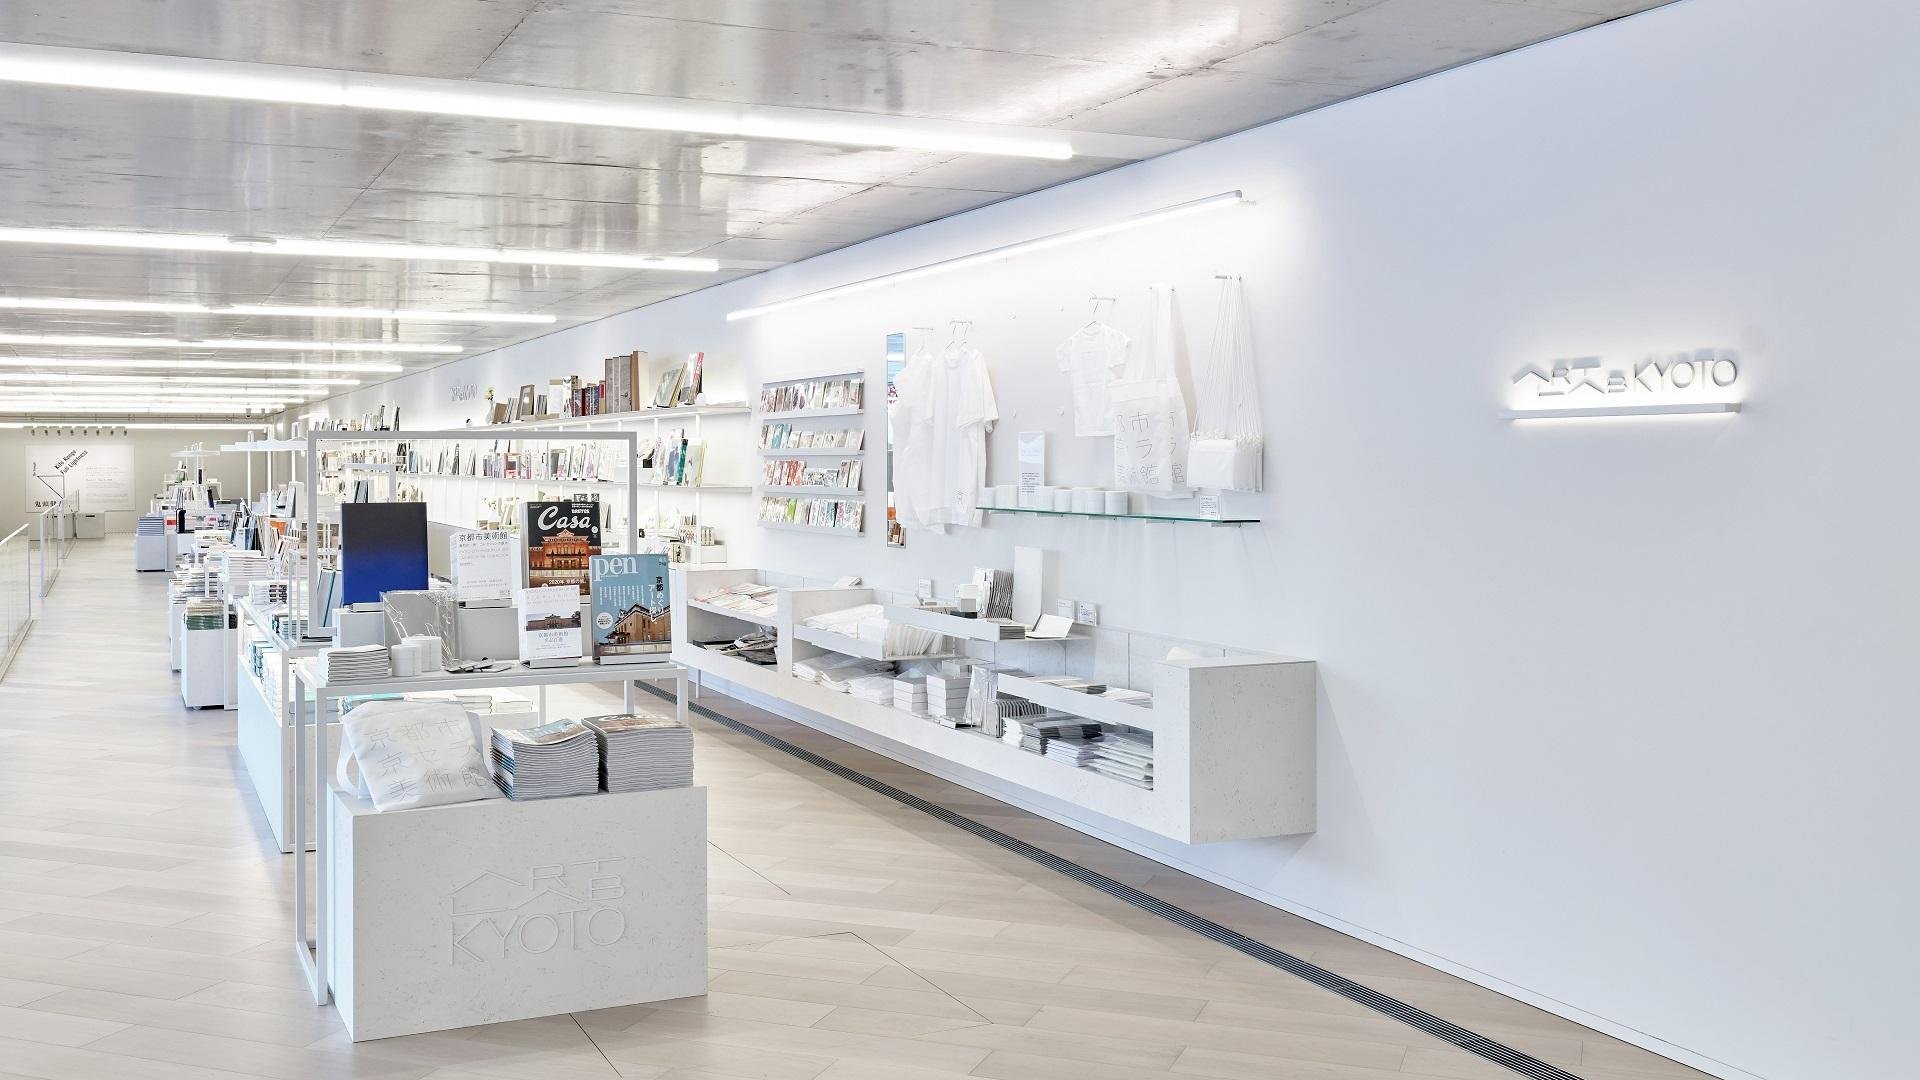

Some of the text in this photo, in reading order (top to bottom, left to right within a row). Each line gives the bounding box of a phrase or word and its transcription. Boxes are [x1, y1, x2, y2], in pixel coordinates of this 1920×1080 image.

[1633, 357, 1738, 392] KYOTO
[538, 505, 592, 531] Casa
[459, 531, 508, 542] 京都市美術館
[593, 557, 639, 582] pen
[364, 719, 461, 751] 京都市
[387, 765, 492, 801] 美術館
[450, 905, 627, 966] KYOTO
